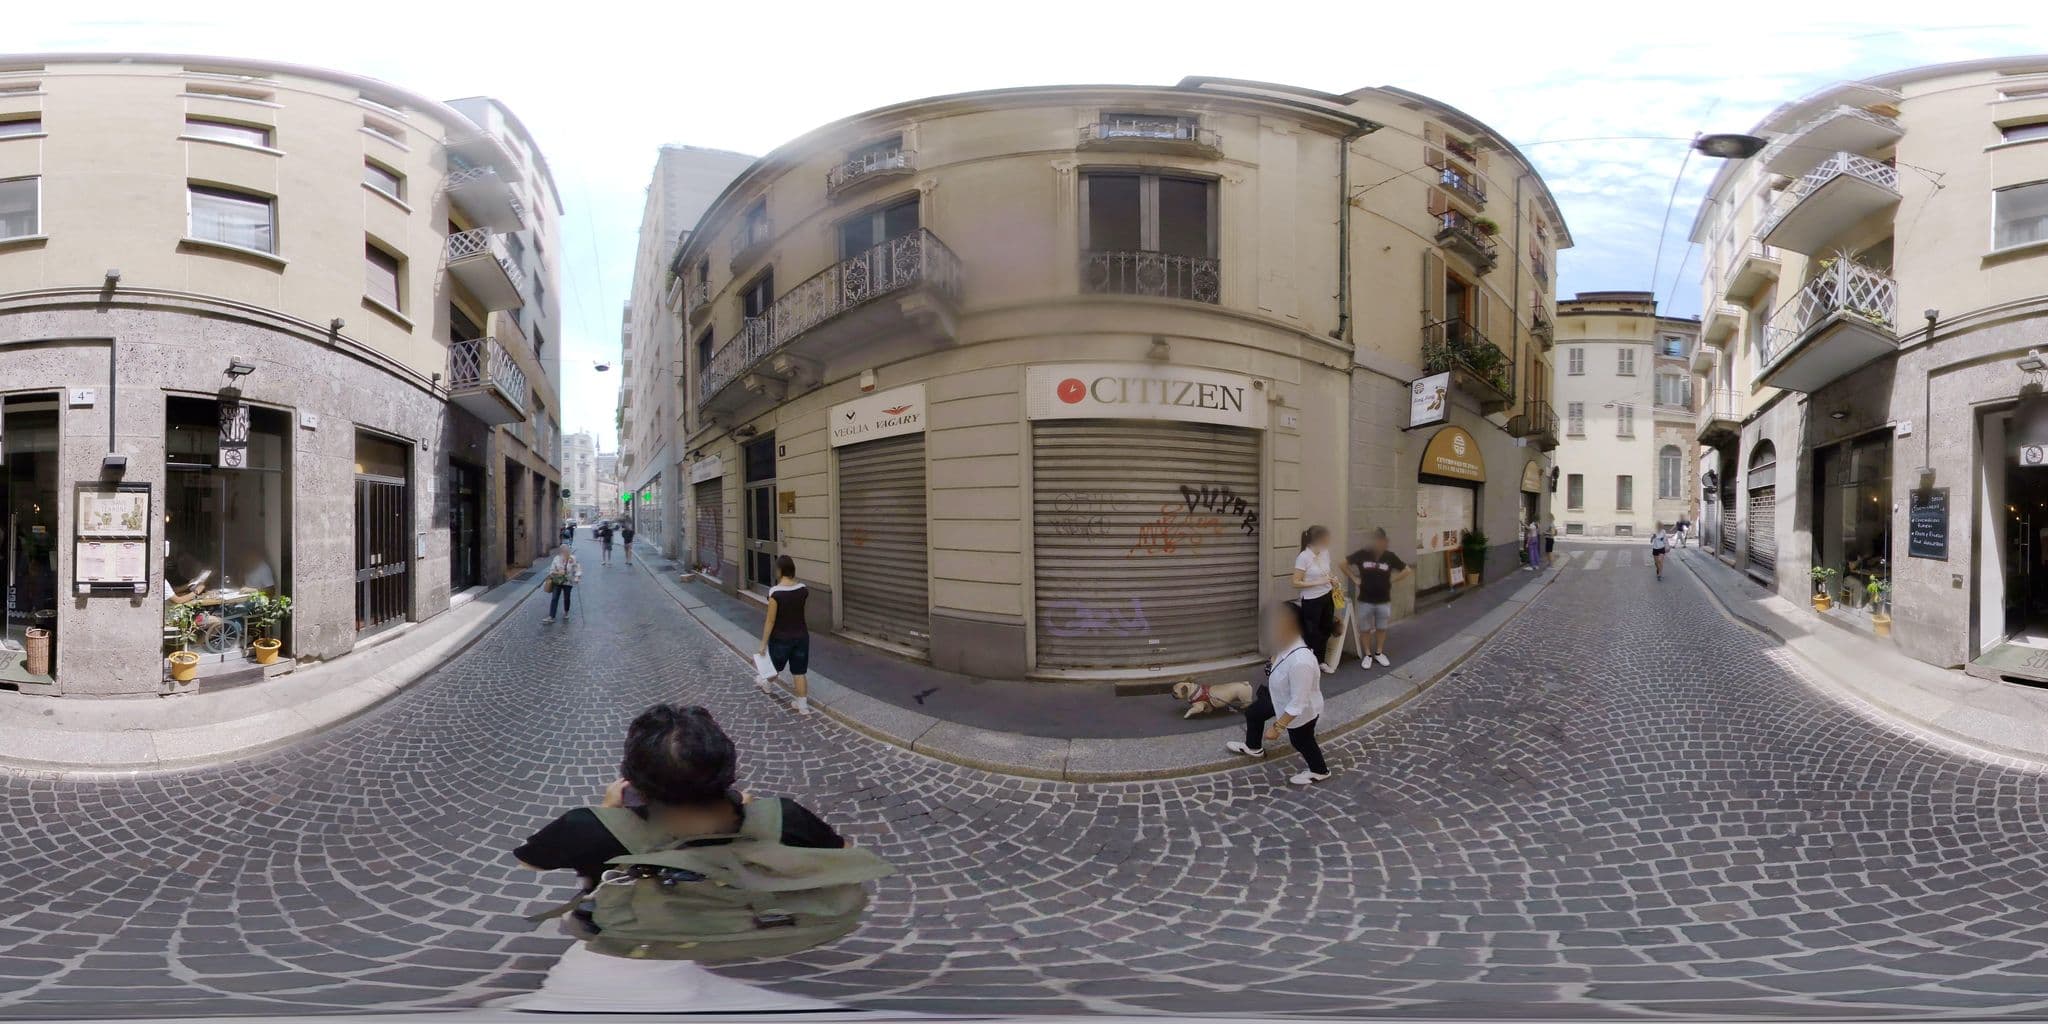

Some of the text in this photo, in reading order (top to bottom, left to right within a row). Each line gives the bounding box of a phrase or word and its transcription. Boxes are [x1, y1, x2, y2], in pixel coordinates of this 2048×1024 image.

[77, 391, 85, 401] 4
[1090, 377, 1244, 412] CITIZEN
[876, 413, 920, 429] VAGARY
[833, 424, 869, 438] VEGLIA
